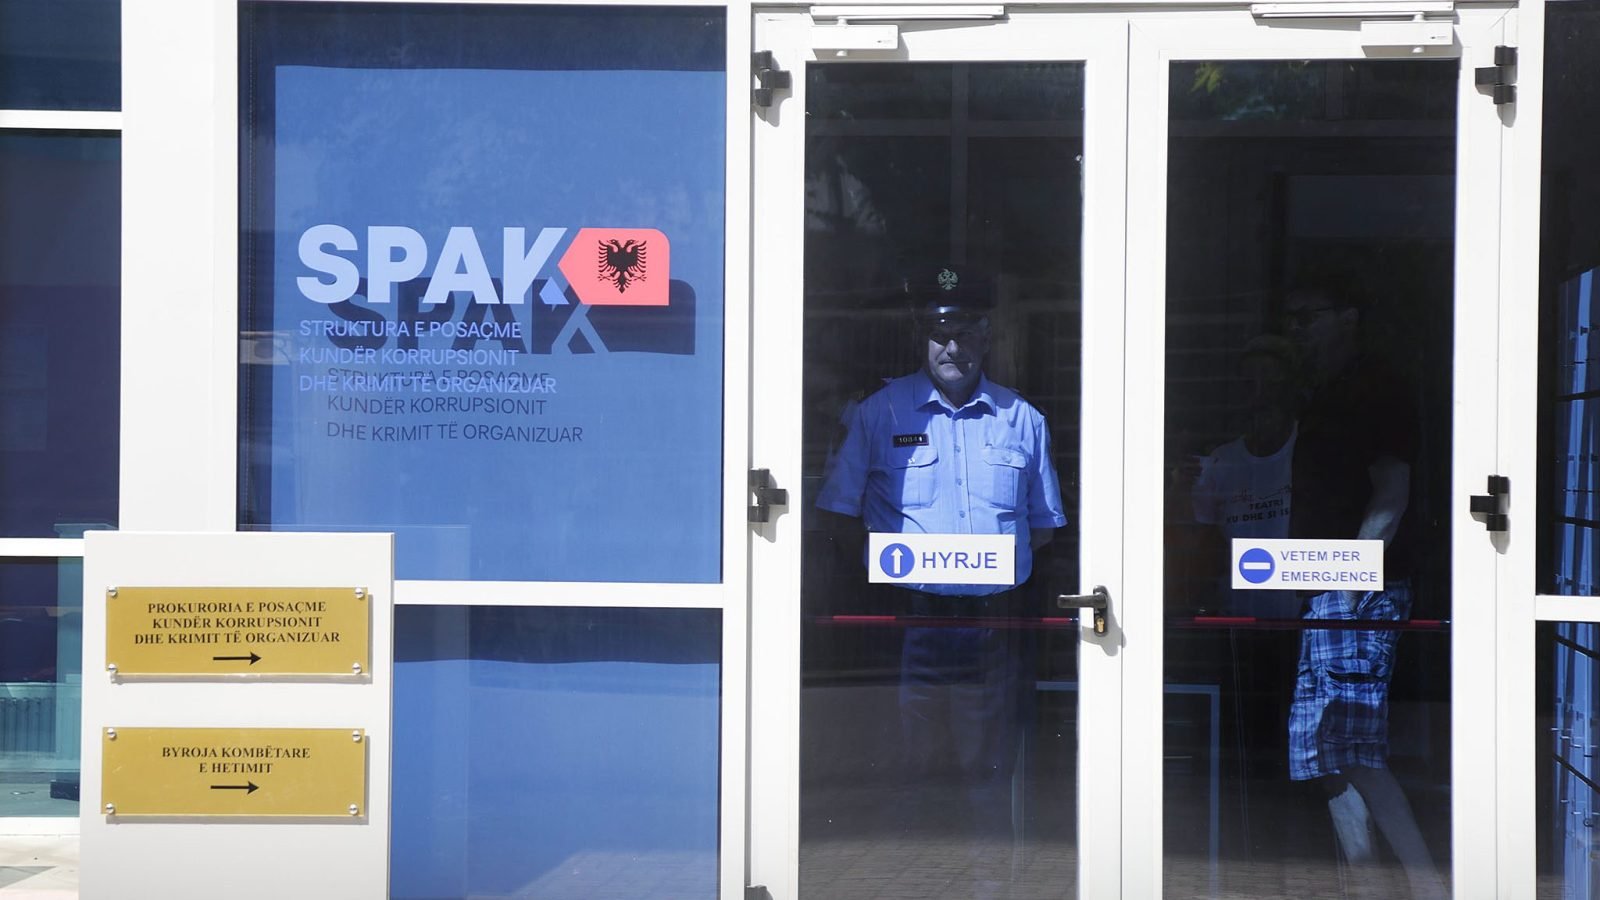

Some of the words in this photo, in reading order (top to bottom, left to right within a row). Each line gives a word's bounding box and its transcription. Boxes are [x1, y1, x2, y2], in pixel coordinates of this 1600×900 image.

[296, 224, 569, 305] SPAK
[299, 320, 410, 337] STRUKTURA
[414, 321, 426, 337] E
[429, 321, 522, 341] POSAÇME
[299, 345, 377, 364] KUNDËR
[381, 348, 520, 366] KORRUPSIONIT
[300, 376, 338, 393] DHE
[342, 375, 401, 393] KRIMIT
[409, 373, 432, 393] TË
[436, 376, 557, 394] ORGANIZUAR
[921, 551, 998, 569] HYRJE
[1280, 551, 1328, 562] VETEM
[1332, 551, 1360, 562] PER
[1281, 571, 1378, 583] EMERGJENCE
[148, 602, 242, 614] PROKURORIA
[246, 602, 254, 613] E
[258, 601, 327, 615] POSAÇME
[152, 616, 212, 629] KUNDËR
[216, 616, 322, 628] KORRUPSIONIT
[135, 633, 164, 645] DHE
[168, 632, 220, 644] KRIMIT
[224, 630, 241, 644] TË
[246, 631, 340, 643] ORGANIZUAR
[162, 747, 218, 758] BYROJA
[222, 745, 311, 759] KOMBËTARE
[199, 763, 208, 774] E
[212, 762, 273, 774] HETIMIT
